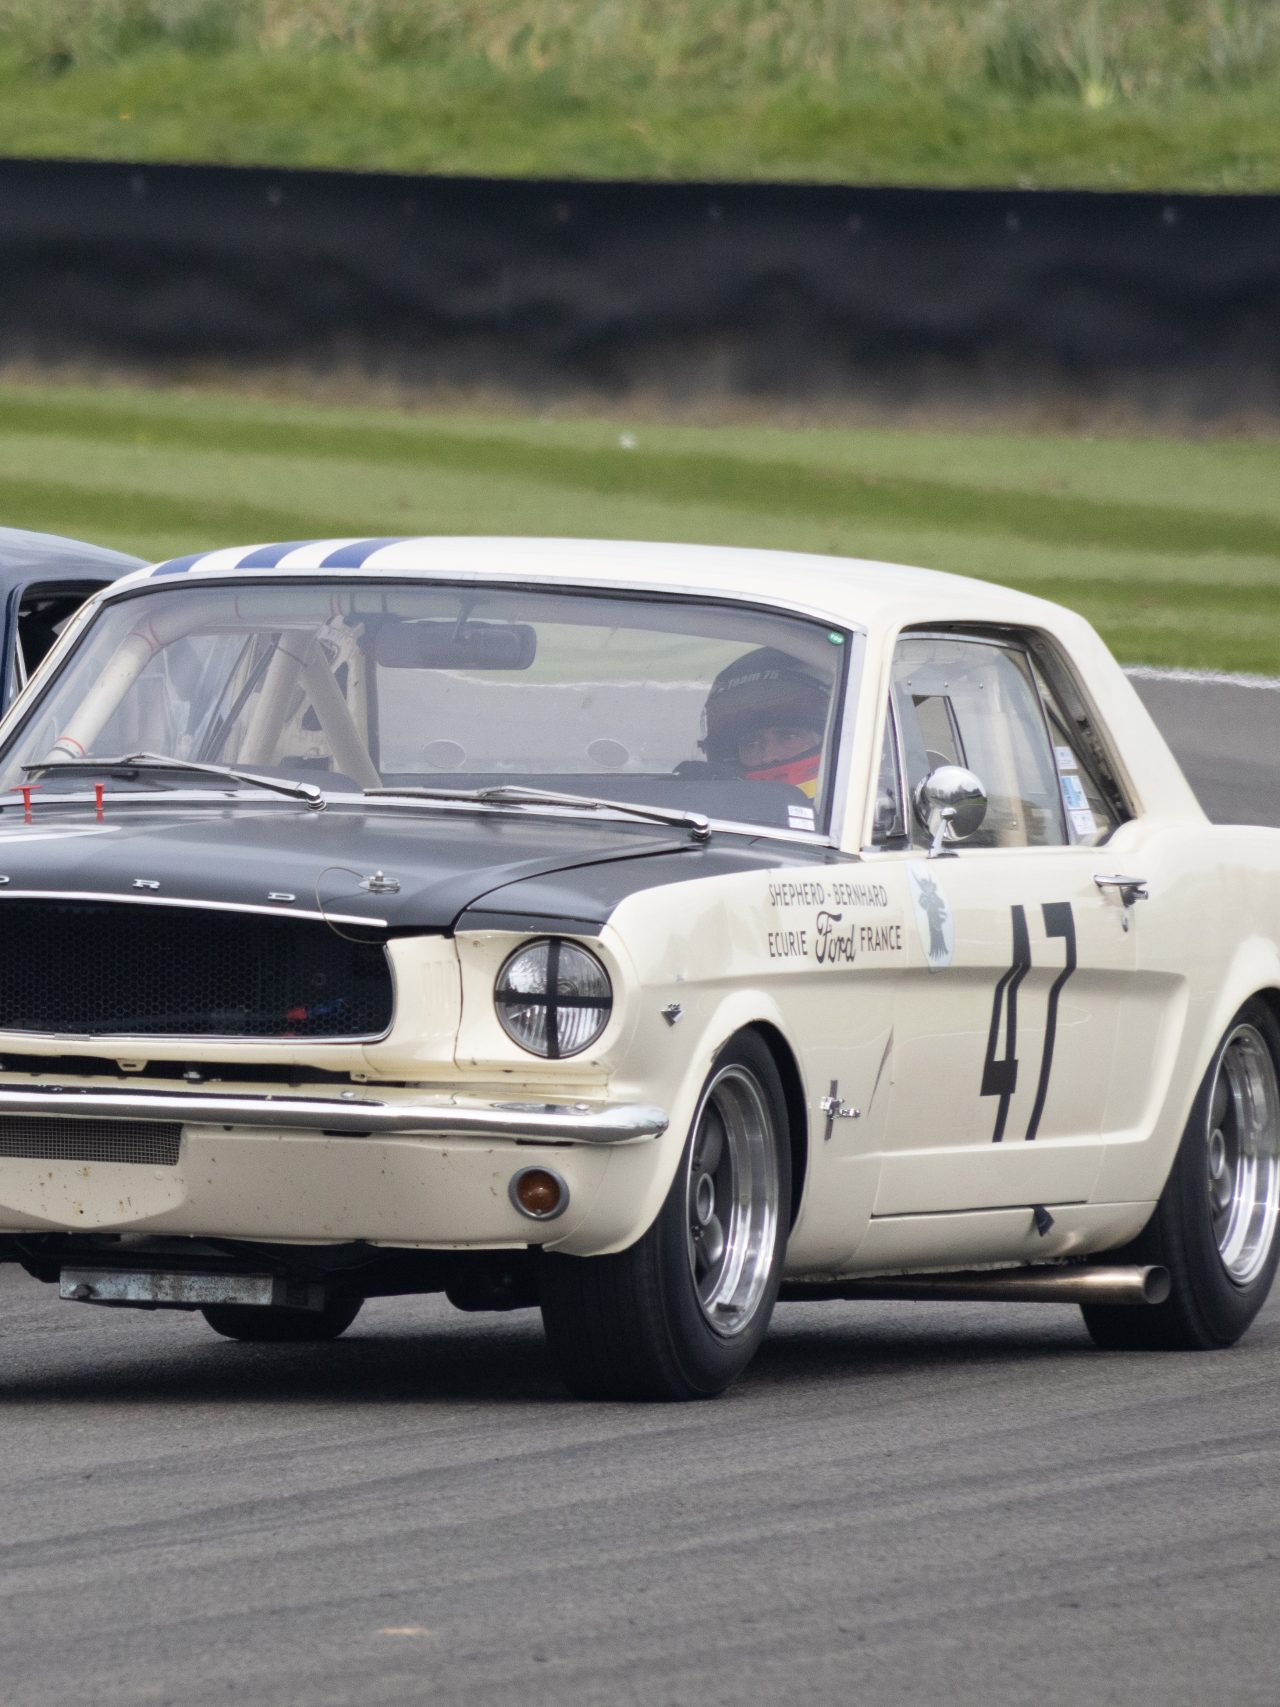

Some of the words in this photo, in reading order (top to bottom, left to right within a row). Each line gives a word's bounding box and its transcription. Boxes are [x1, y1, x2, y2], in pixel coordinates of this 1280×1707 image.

[768, 882, 825, 907] SHEPHERD
[832, 883, 888, 907] BERNHARD
[767, 930, 808, 958] ECURIE
[815, 910, 856, 964] Ford
[860, 925, 902, 952] FRANCE
[980, 901, 1077, 1143] 47
